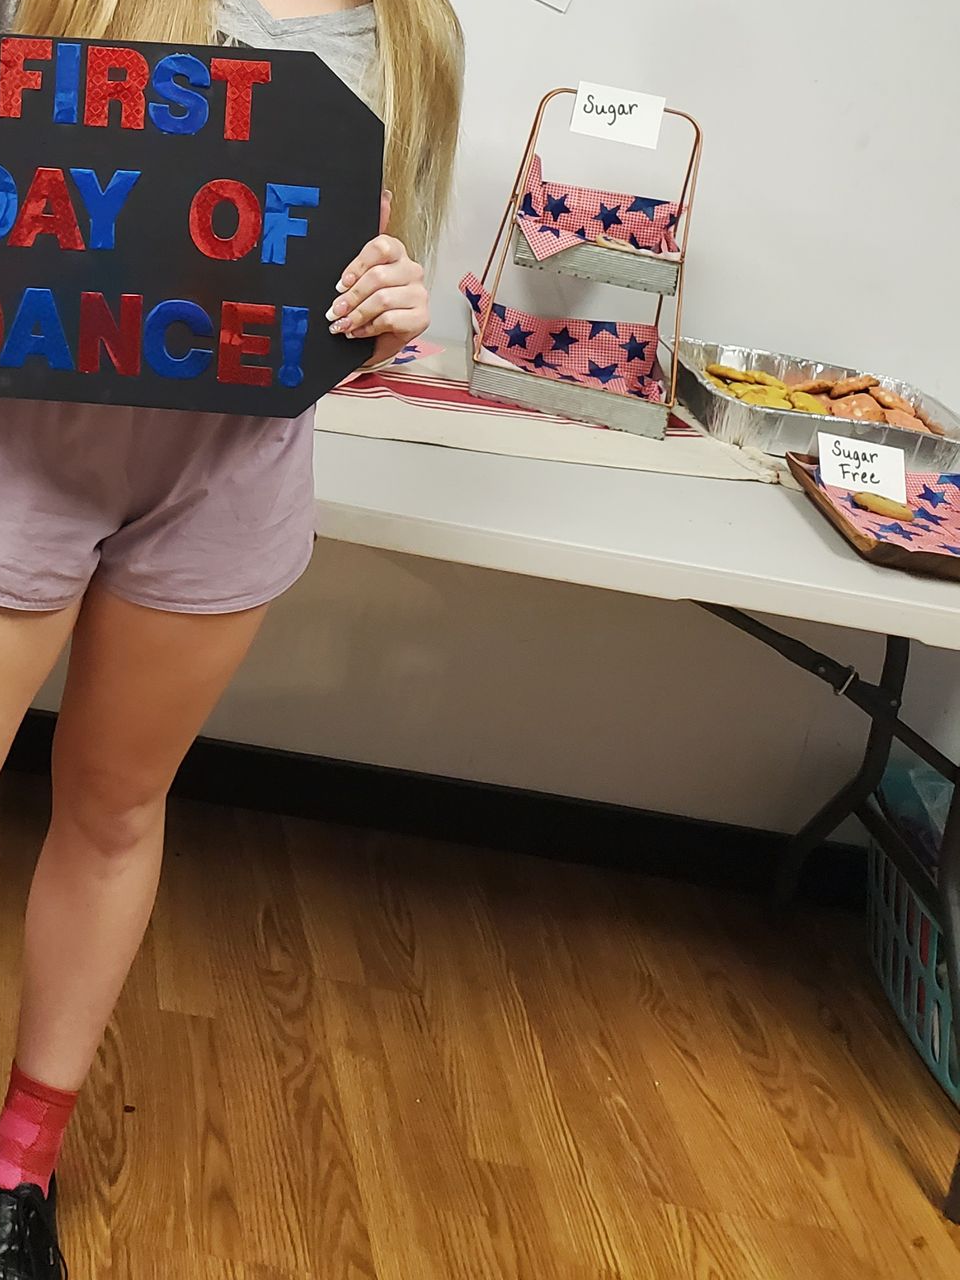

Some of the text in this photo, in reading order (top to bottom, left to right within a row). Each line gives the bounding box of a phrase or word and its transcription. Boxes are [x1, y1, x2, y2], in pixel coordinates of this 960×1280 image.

[583, 94, 638, 126] Sugar
[189, 179, 320, 265] OF
[832, 440, 878, 469] Sugar
[838, 463, 880, 484] Free
